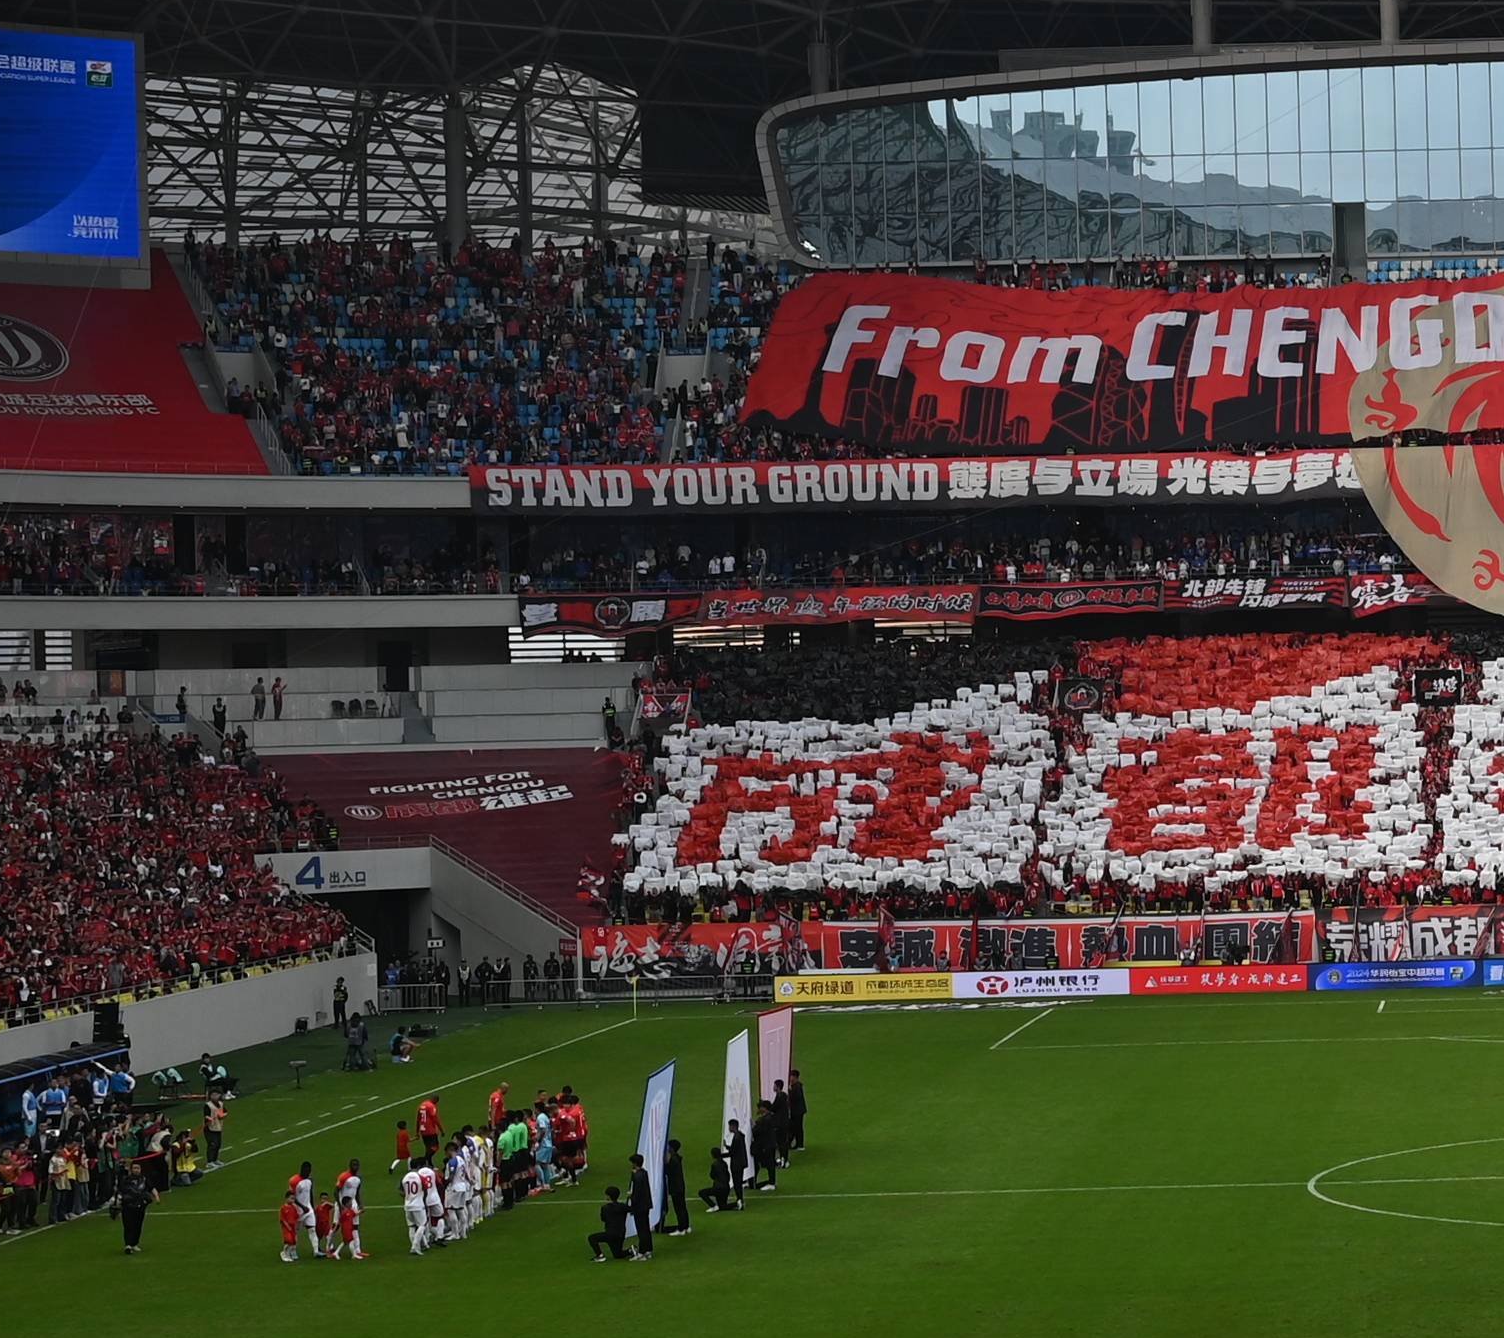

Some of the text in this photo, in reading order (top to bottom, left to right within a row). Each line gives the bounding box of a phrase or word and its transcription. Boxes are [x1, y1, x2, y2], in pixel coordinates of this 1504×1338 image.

[821, 304, 1102, 384] From
[25, 405, 134, 417] RONGCHENG
[138, 406, 161, 416] FC
[484, 467, 634, 509] STAND
[643, 466, 760, 508] YOUR
[767, 461, 939, 504] GROUND
[1182, 577, 1267, 599] 北部先锋
[368, 770, 532, 795] FIGHTING FOR
[432, 779, 546, 800] CHENGDU
[384, 784, 574, 819] 成都雄起
[295, 856, 325, 890] 4
[329, 871, 366, 884] 出入口
[797, 980, 855, 996] 天府绿道
[1013, 973, 1100, 988] 泸州银行
[405, 1180, 419, 1195] 10
